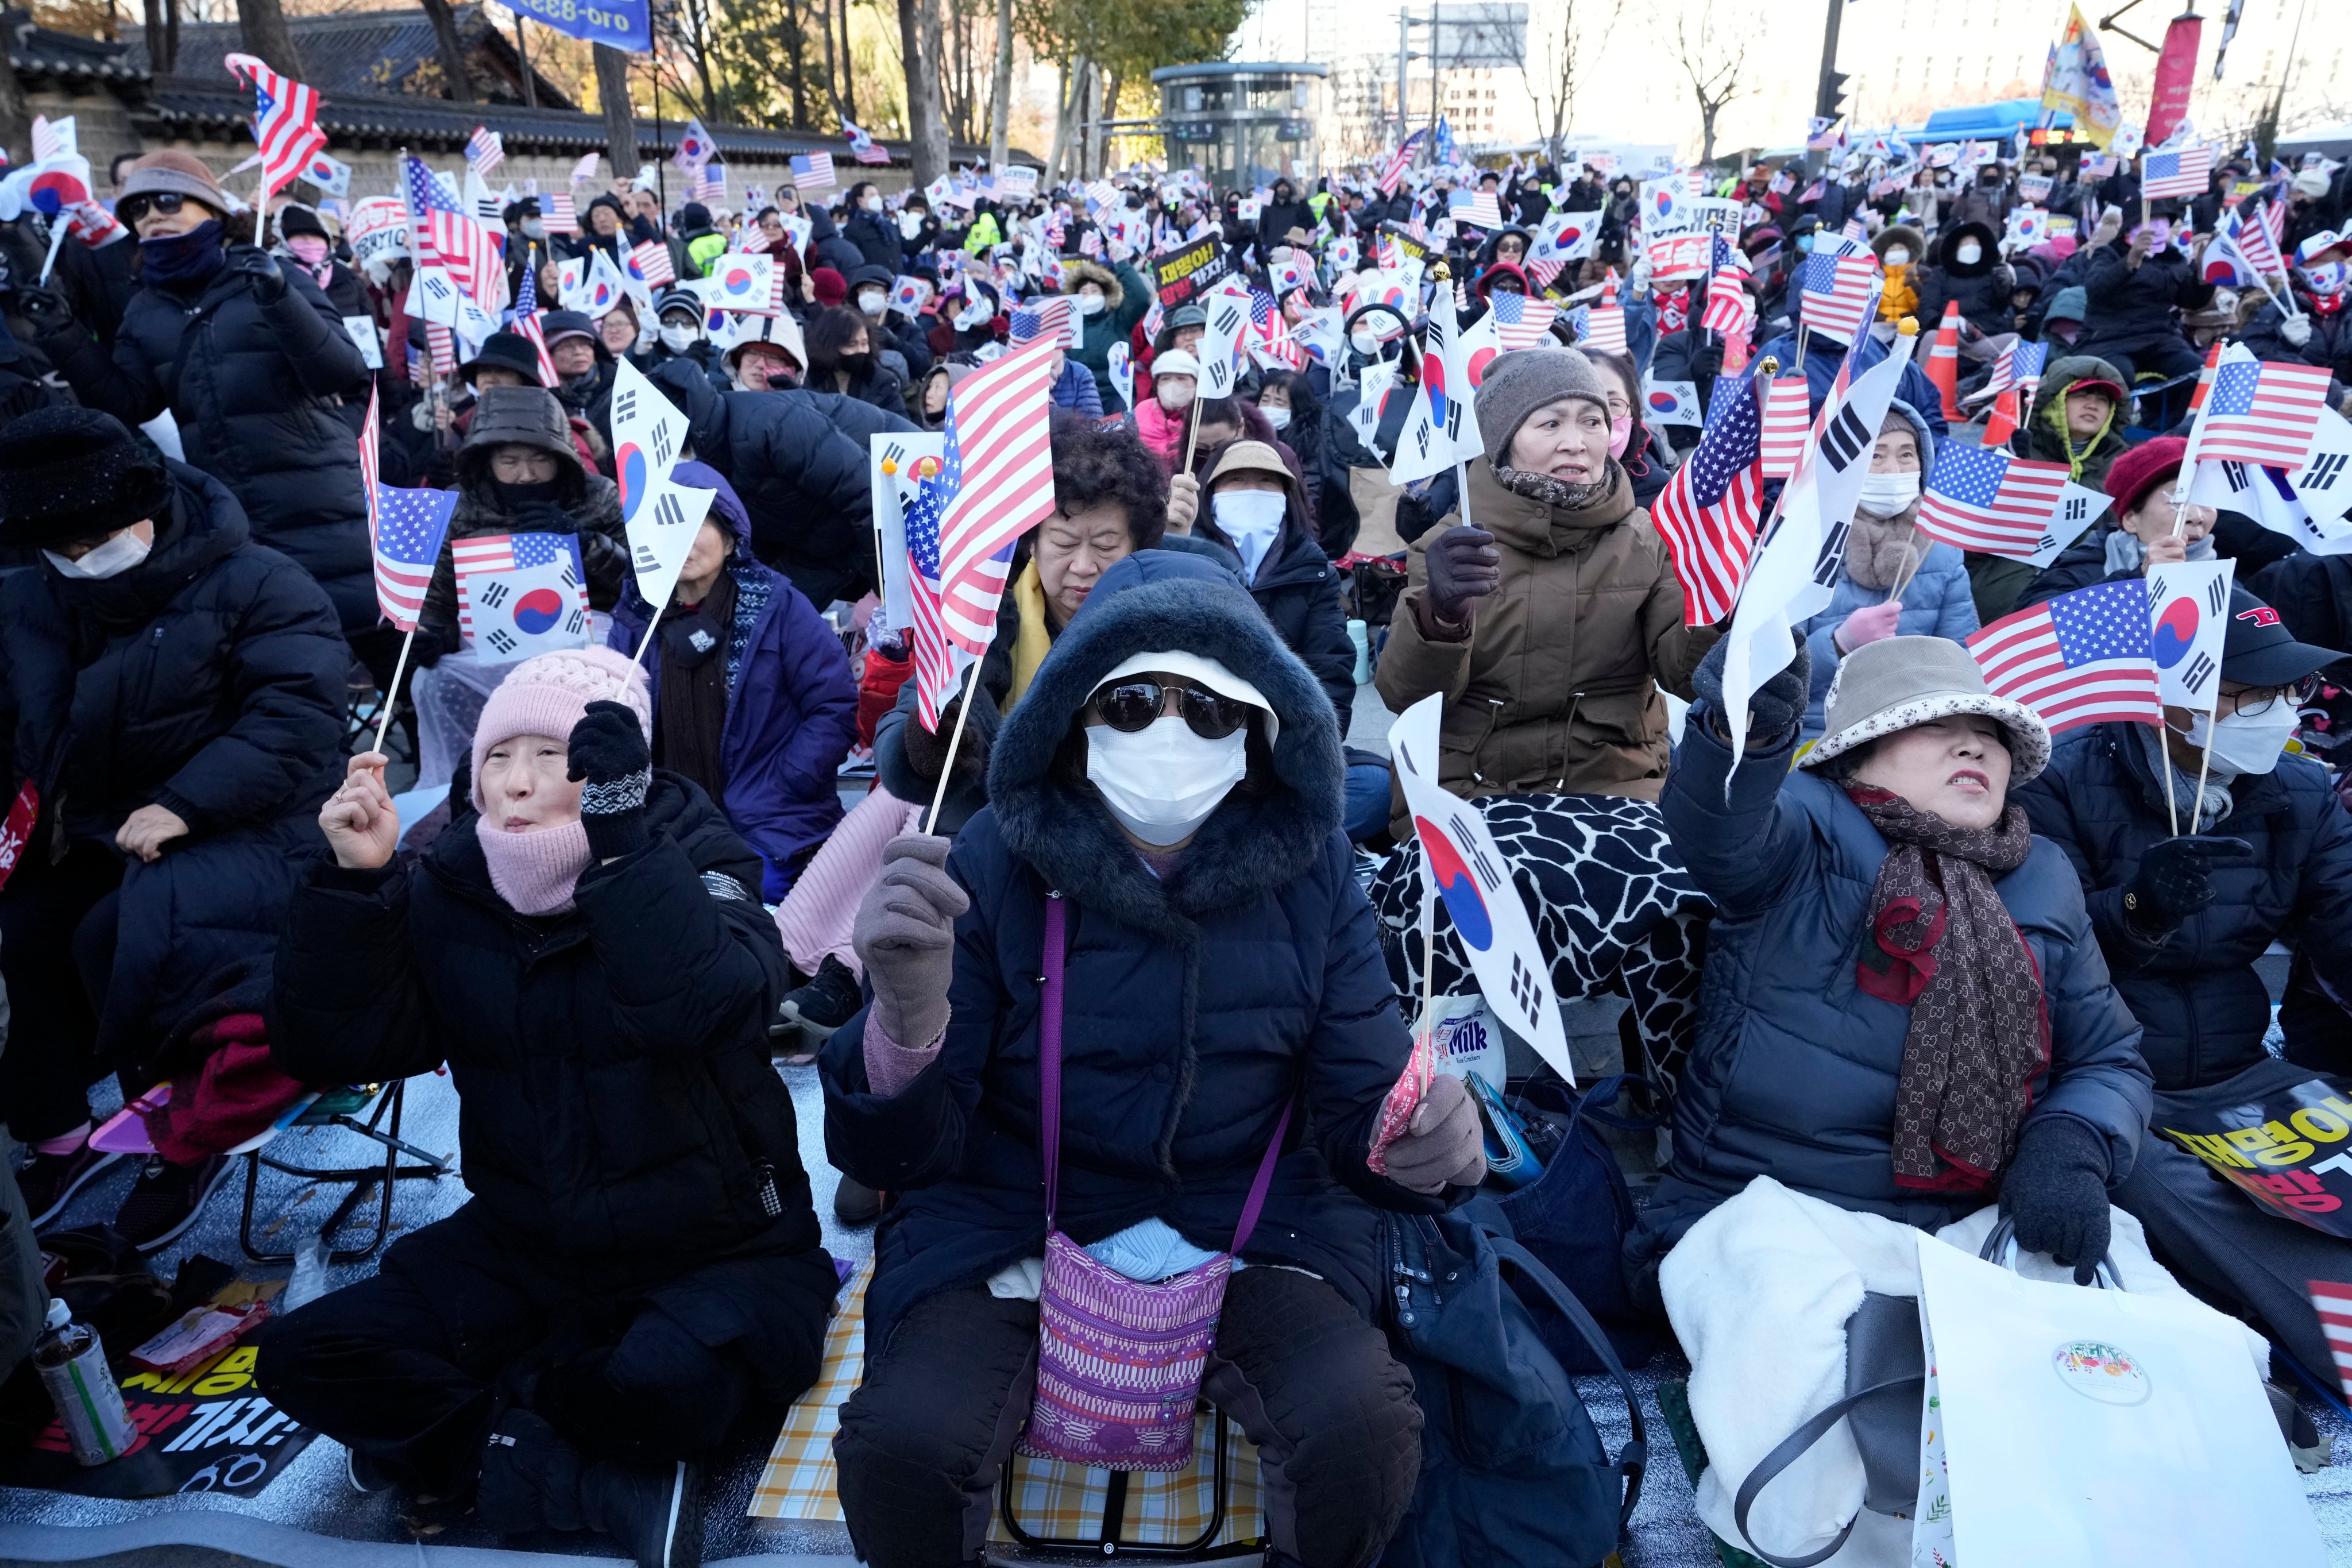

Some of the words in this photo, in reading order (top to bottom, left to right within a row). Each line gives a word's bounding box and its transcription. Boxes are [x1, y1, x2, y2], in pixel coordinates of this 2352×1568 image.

[707, 870, 740, 885] REALISTIC
[1449, 1021, 1488, 1055] Milk
[1463, 1055, 1481, 1064] Crackers
